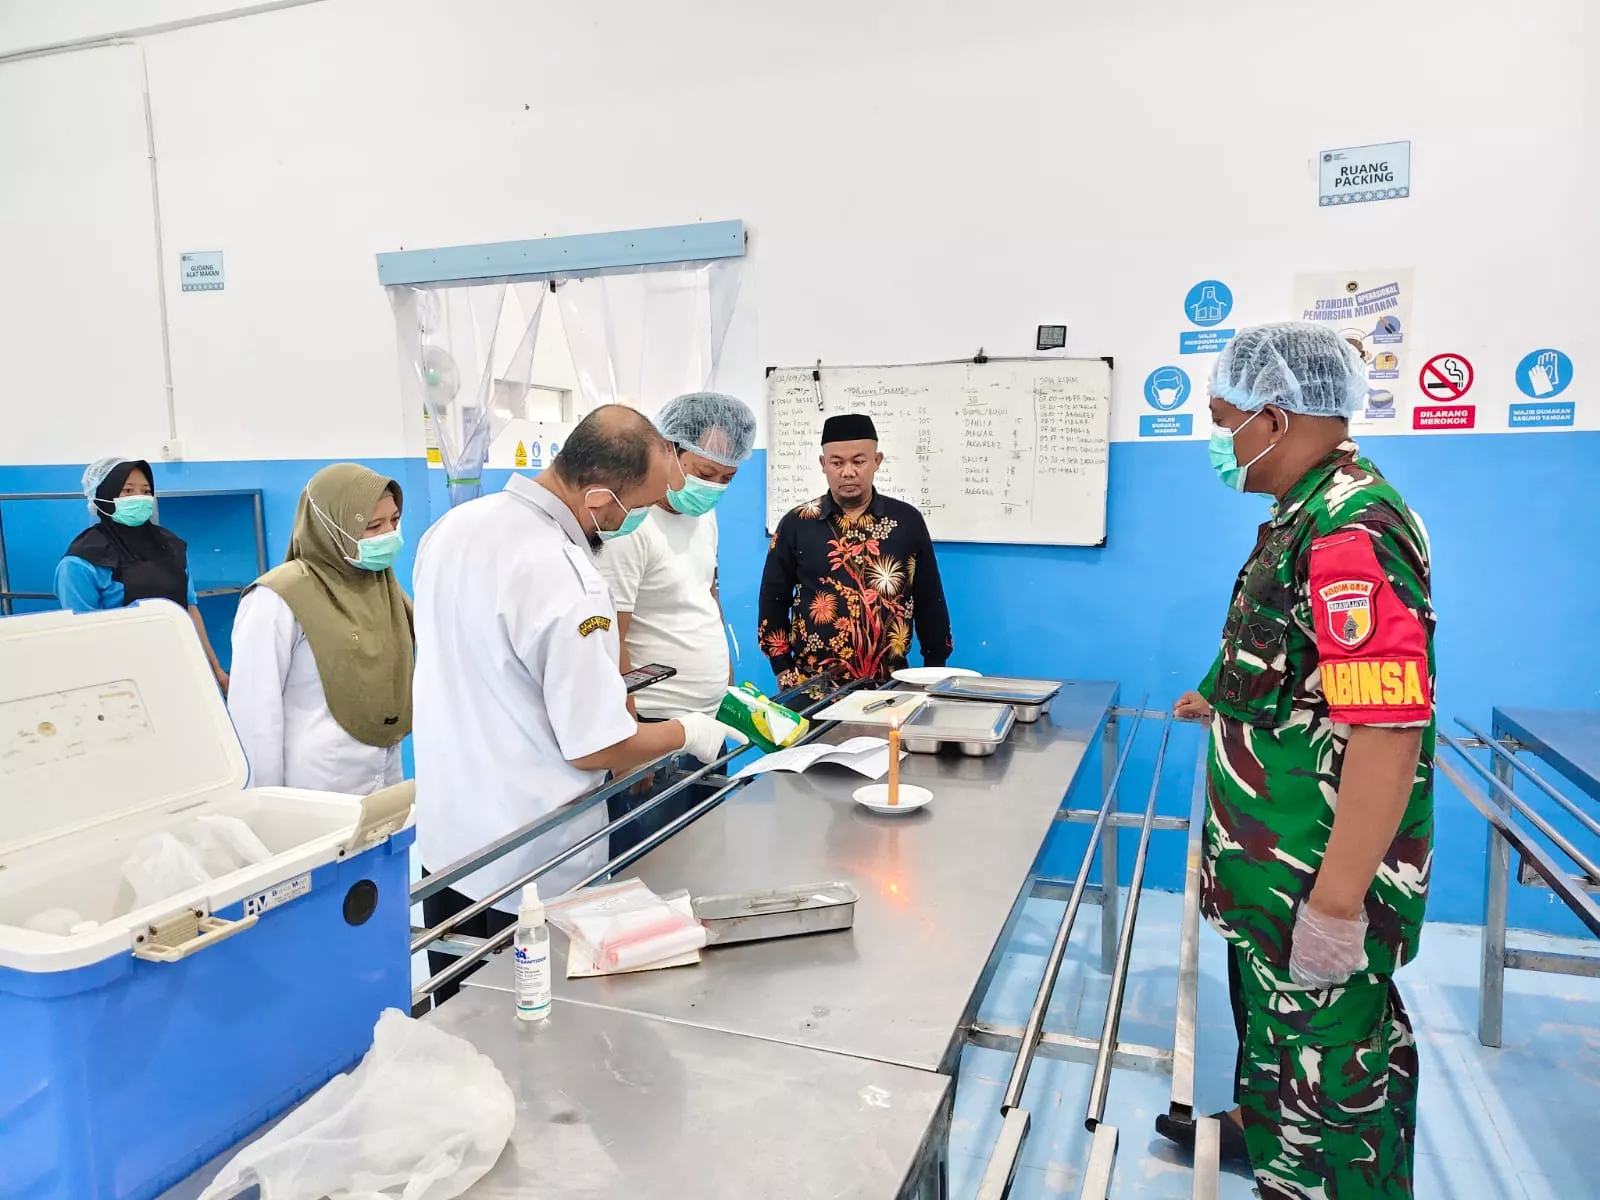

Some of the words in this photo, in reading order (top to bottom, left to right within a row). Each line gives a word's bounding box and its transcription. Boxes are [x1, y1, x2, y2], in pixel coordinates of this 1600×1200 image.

[1341, 161, 1388, 176] RUANG
[1335, 172, 1394, 187] PACKING
[200, 269, 219, 277] MAKAN
[1316, 297, 1354, 310] STANDAR
[1357, 285, 1398, 303] OPERASIONAL
[1303, 308, 1353, 320] PEMORSIAN
[1355, 296, 1398, 317] MAKANAN
[1420, 410, 1469, 418] DILARANG
[1420, 417, 1468, 425] MEROKOK
[1324, 584, 1349, 597] KODIM
[1321, 661, 1424, 705] ABINSA
